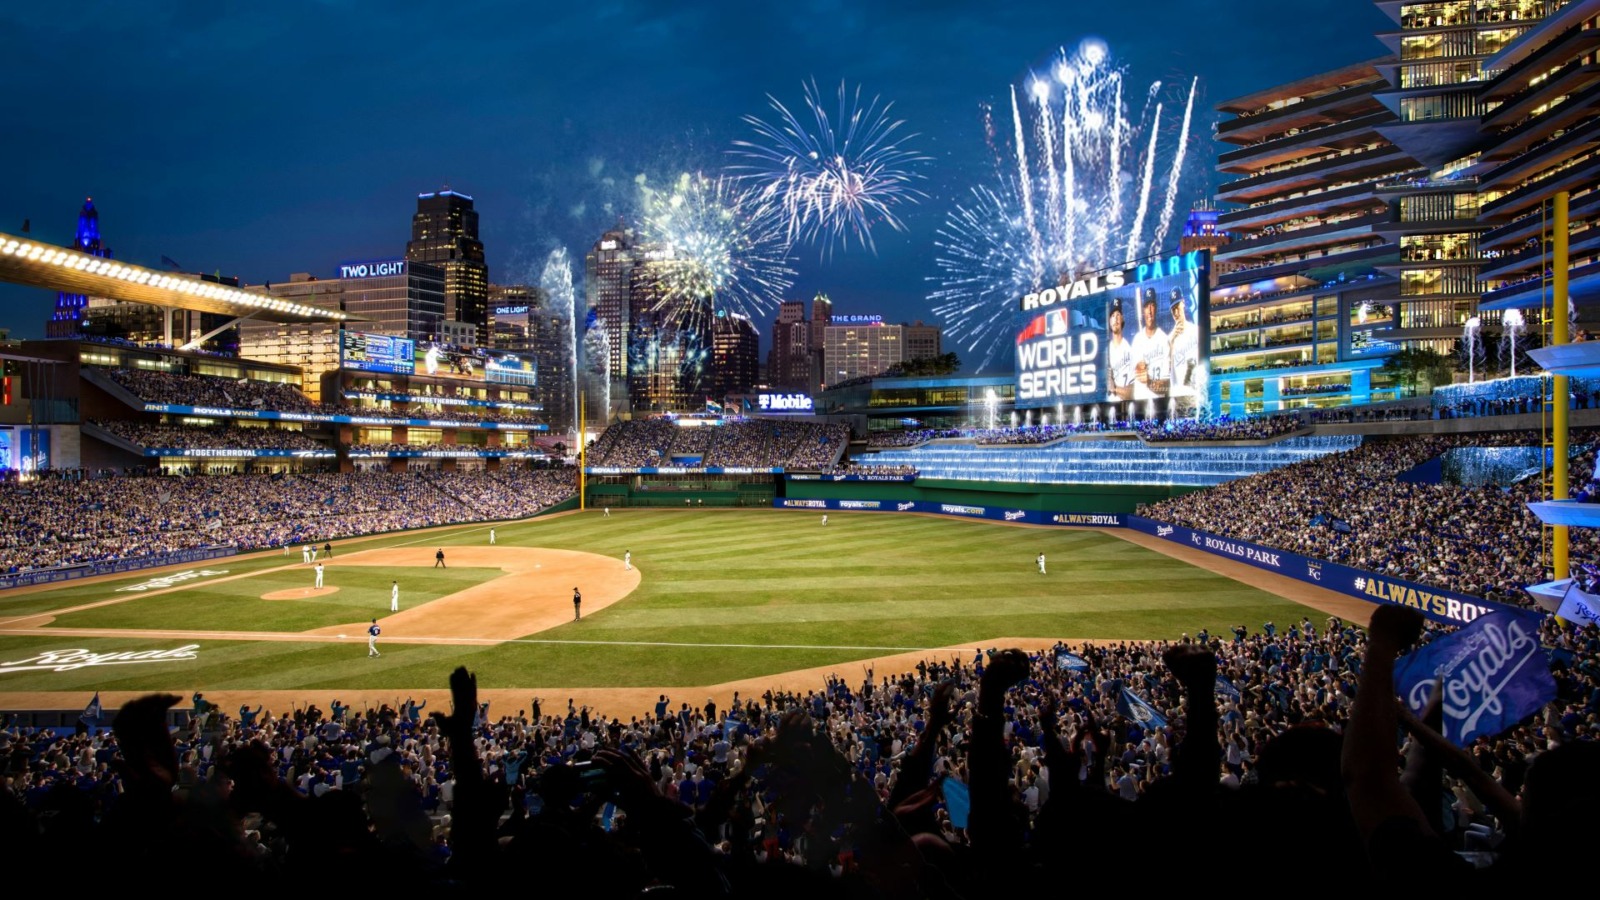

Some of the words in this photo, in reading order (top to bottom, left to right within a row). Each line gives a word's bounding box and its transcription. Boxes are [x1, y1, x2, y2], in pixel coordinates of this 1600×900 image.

[341, 264, 368, 279] TWO
[370, 262, 404, 277] LIGHT
[1023, 270, 1125, 311] ROYALS
[1138, 250, 1200, 283] PARK
[510, 306, 529, 314] LIGHT
[850, 314, 882, 322] GRAND
[1018, 331, 1099, 371] WORLD
[1019, 364, 1097, 399] SERIES
[411, 396, 469, 406] #TOGETHERROYAL
[770, 393, 813, 410] Mobile
[193, 407, 232, 416] ROYALS
[281, 413, 312, 421] ROYALS
[184, 449, 257, 457] #TOGETHERROYAL
[784, 500, 827, 508] #ALWAYSROYAL
[841, 501, 880, 509] royals.com
[943, 505, 984, 515] royals.com
[1004, 510, 1026, 521] Royals
[1053, 514, 1120, 525] #ALWAYSROYAL
[1157, 525, 1174, 536] Royals
[1205, 536, 1245, 557] ROYALS
[1246, 548, 1281, 567] PARK
[1354, 577, 1497, 623] #ALWAYSRO
[1575, 602, 1600, 623] Roy
[0, 644, 200, 673] Royals
[1409, 619, 1537, 742] Royals
